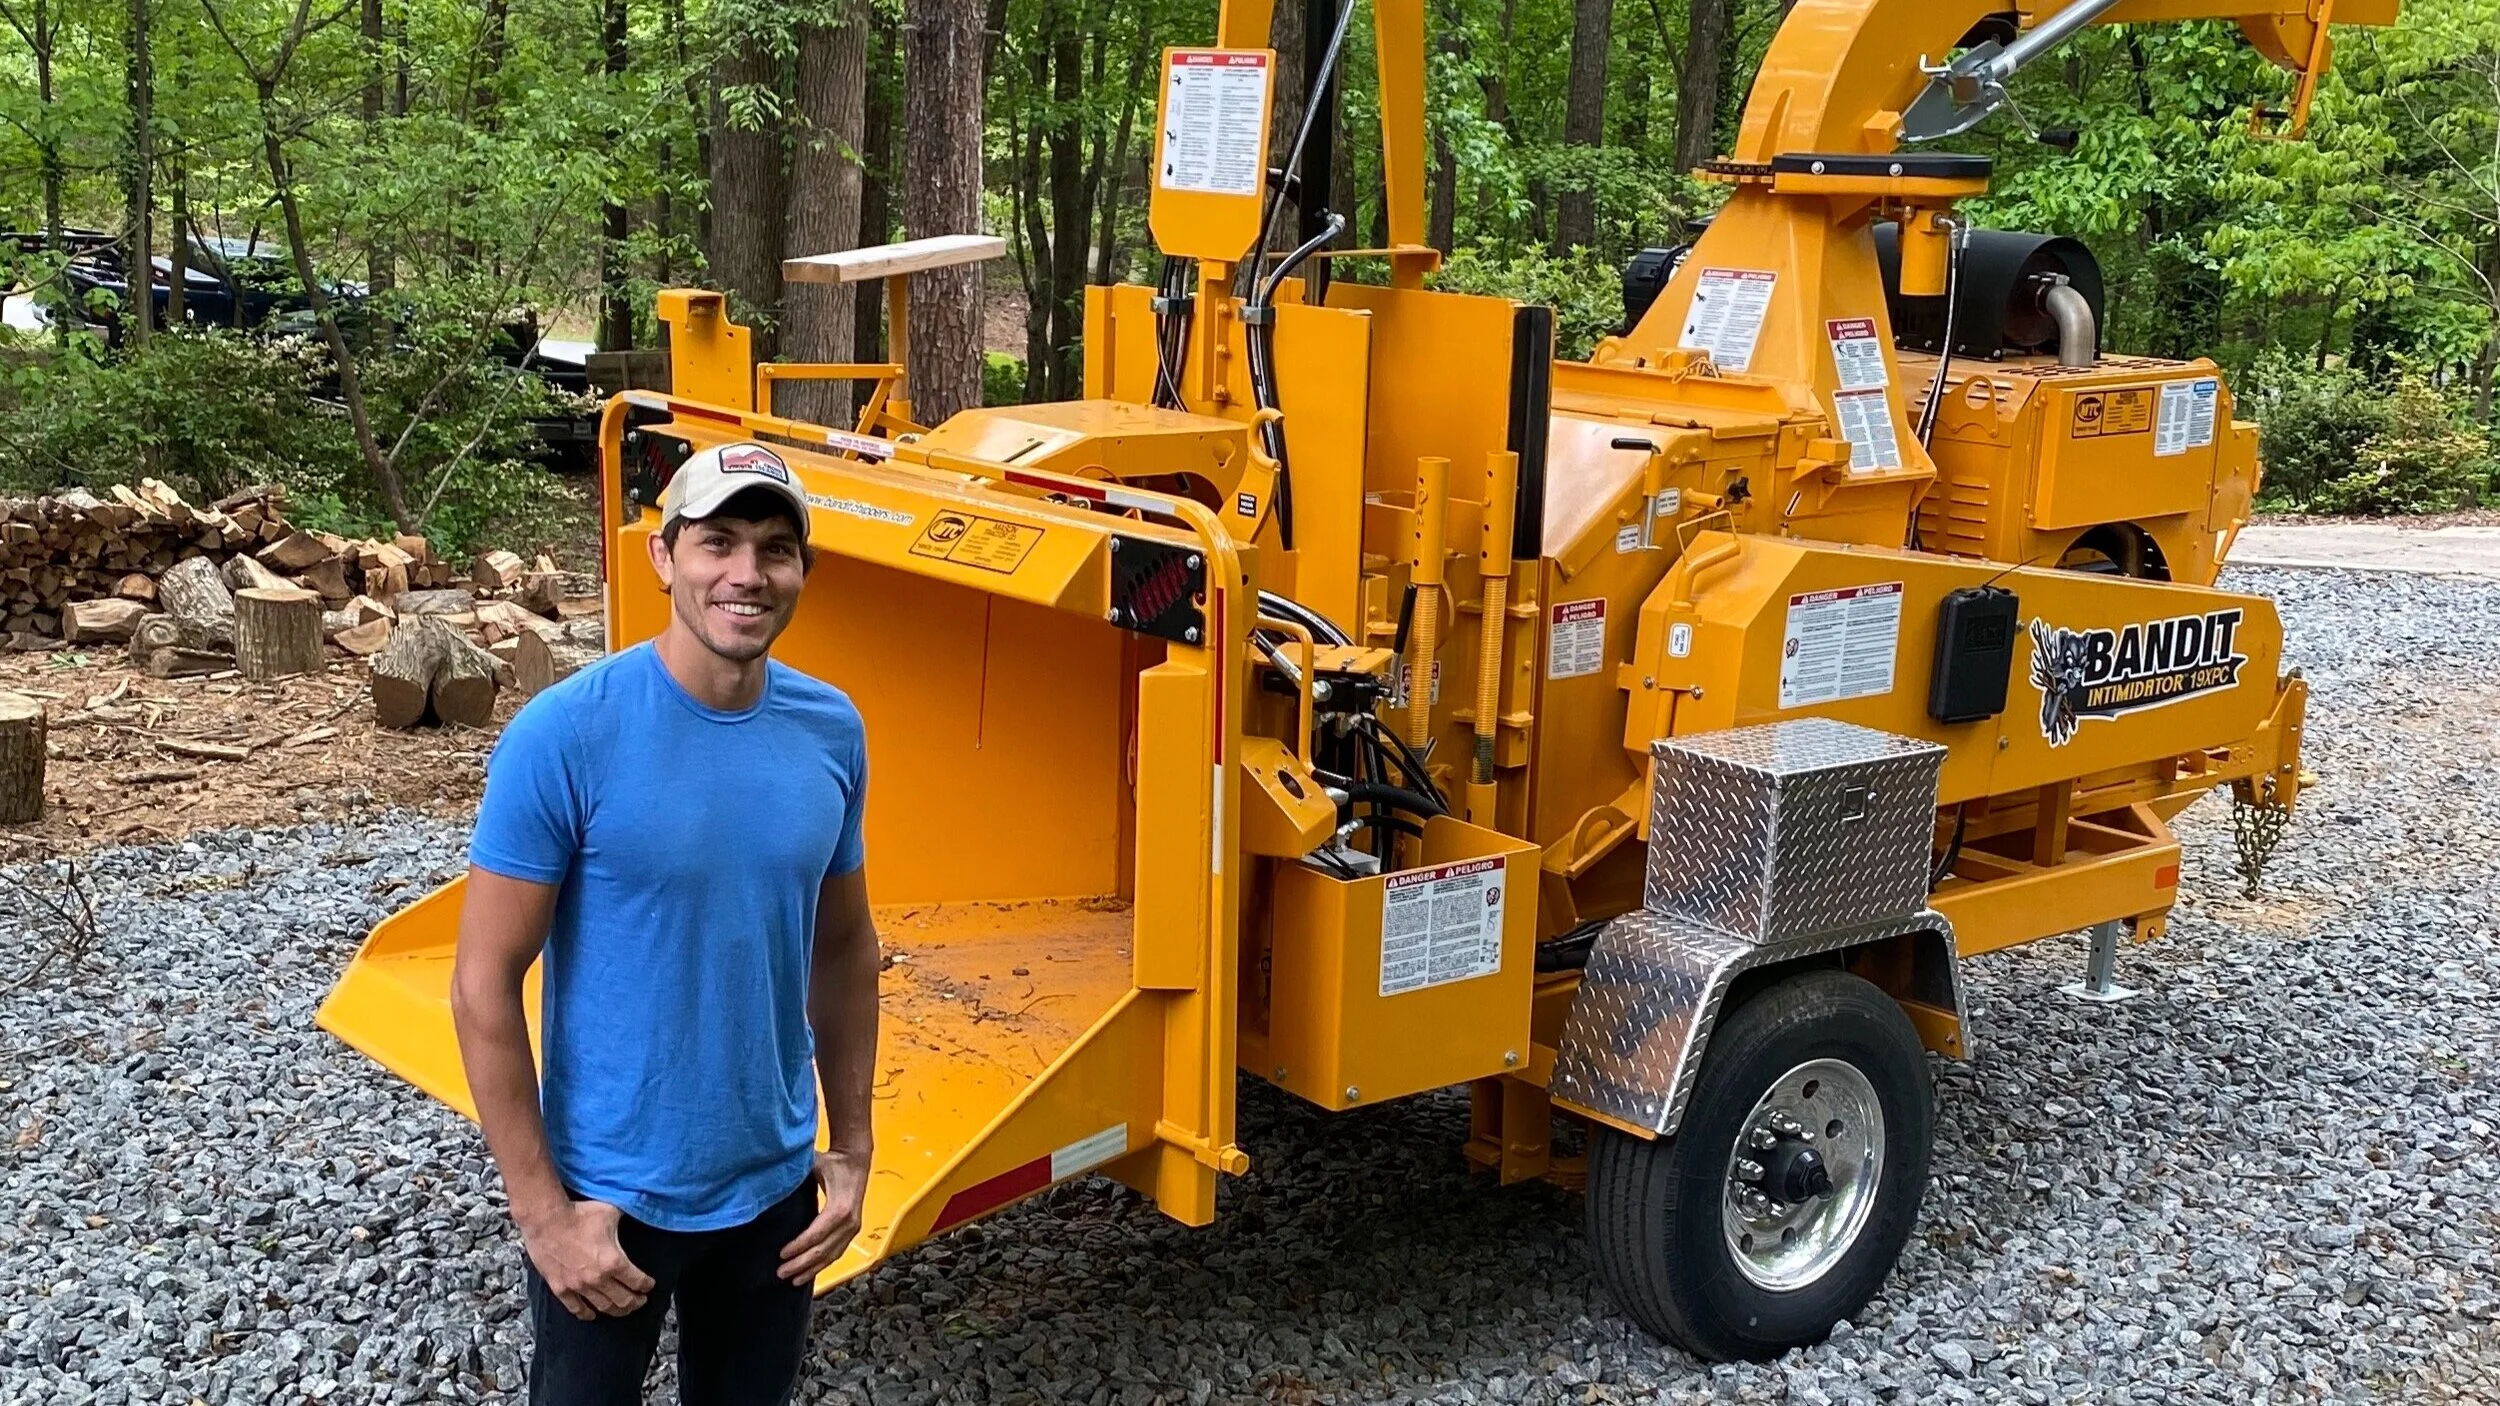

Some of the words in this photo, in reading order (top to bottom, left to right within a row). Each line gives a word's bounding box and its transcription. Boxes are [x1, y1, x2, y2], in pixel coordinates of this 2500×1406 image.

[1845, 330, 1869, 338] PELIGRO
[1863, 585, 1894, 595] PELIGRO
[1808, 592, 1839, 603] DANGER
[1569, 602, 1597, 612] DANGER
[1568, 611, 1597, 621] PELIGRO
[2083, 611, 2242, 684] BANDIT
[2189, 665, 2231, 690] 19XPC
[1455, 860, 1494, 875] PELIGRO
[1398, 871, 1437, 886] DANGER
